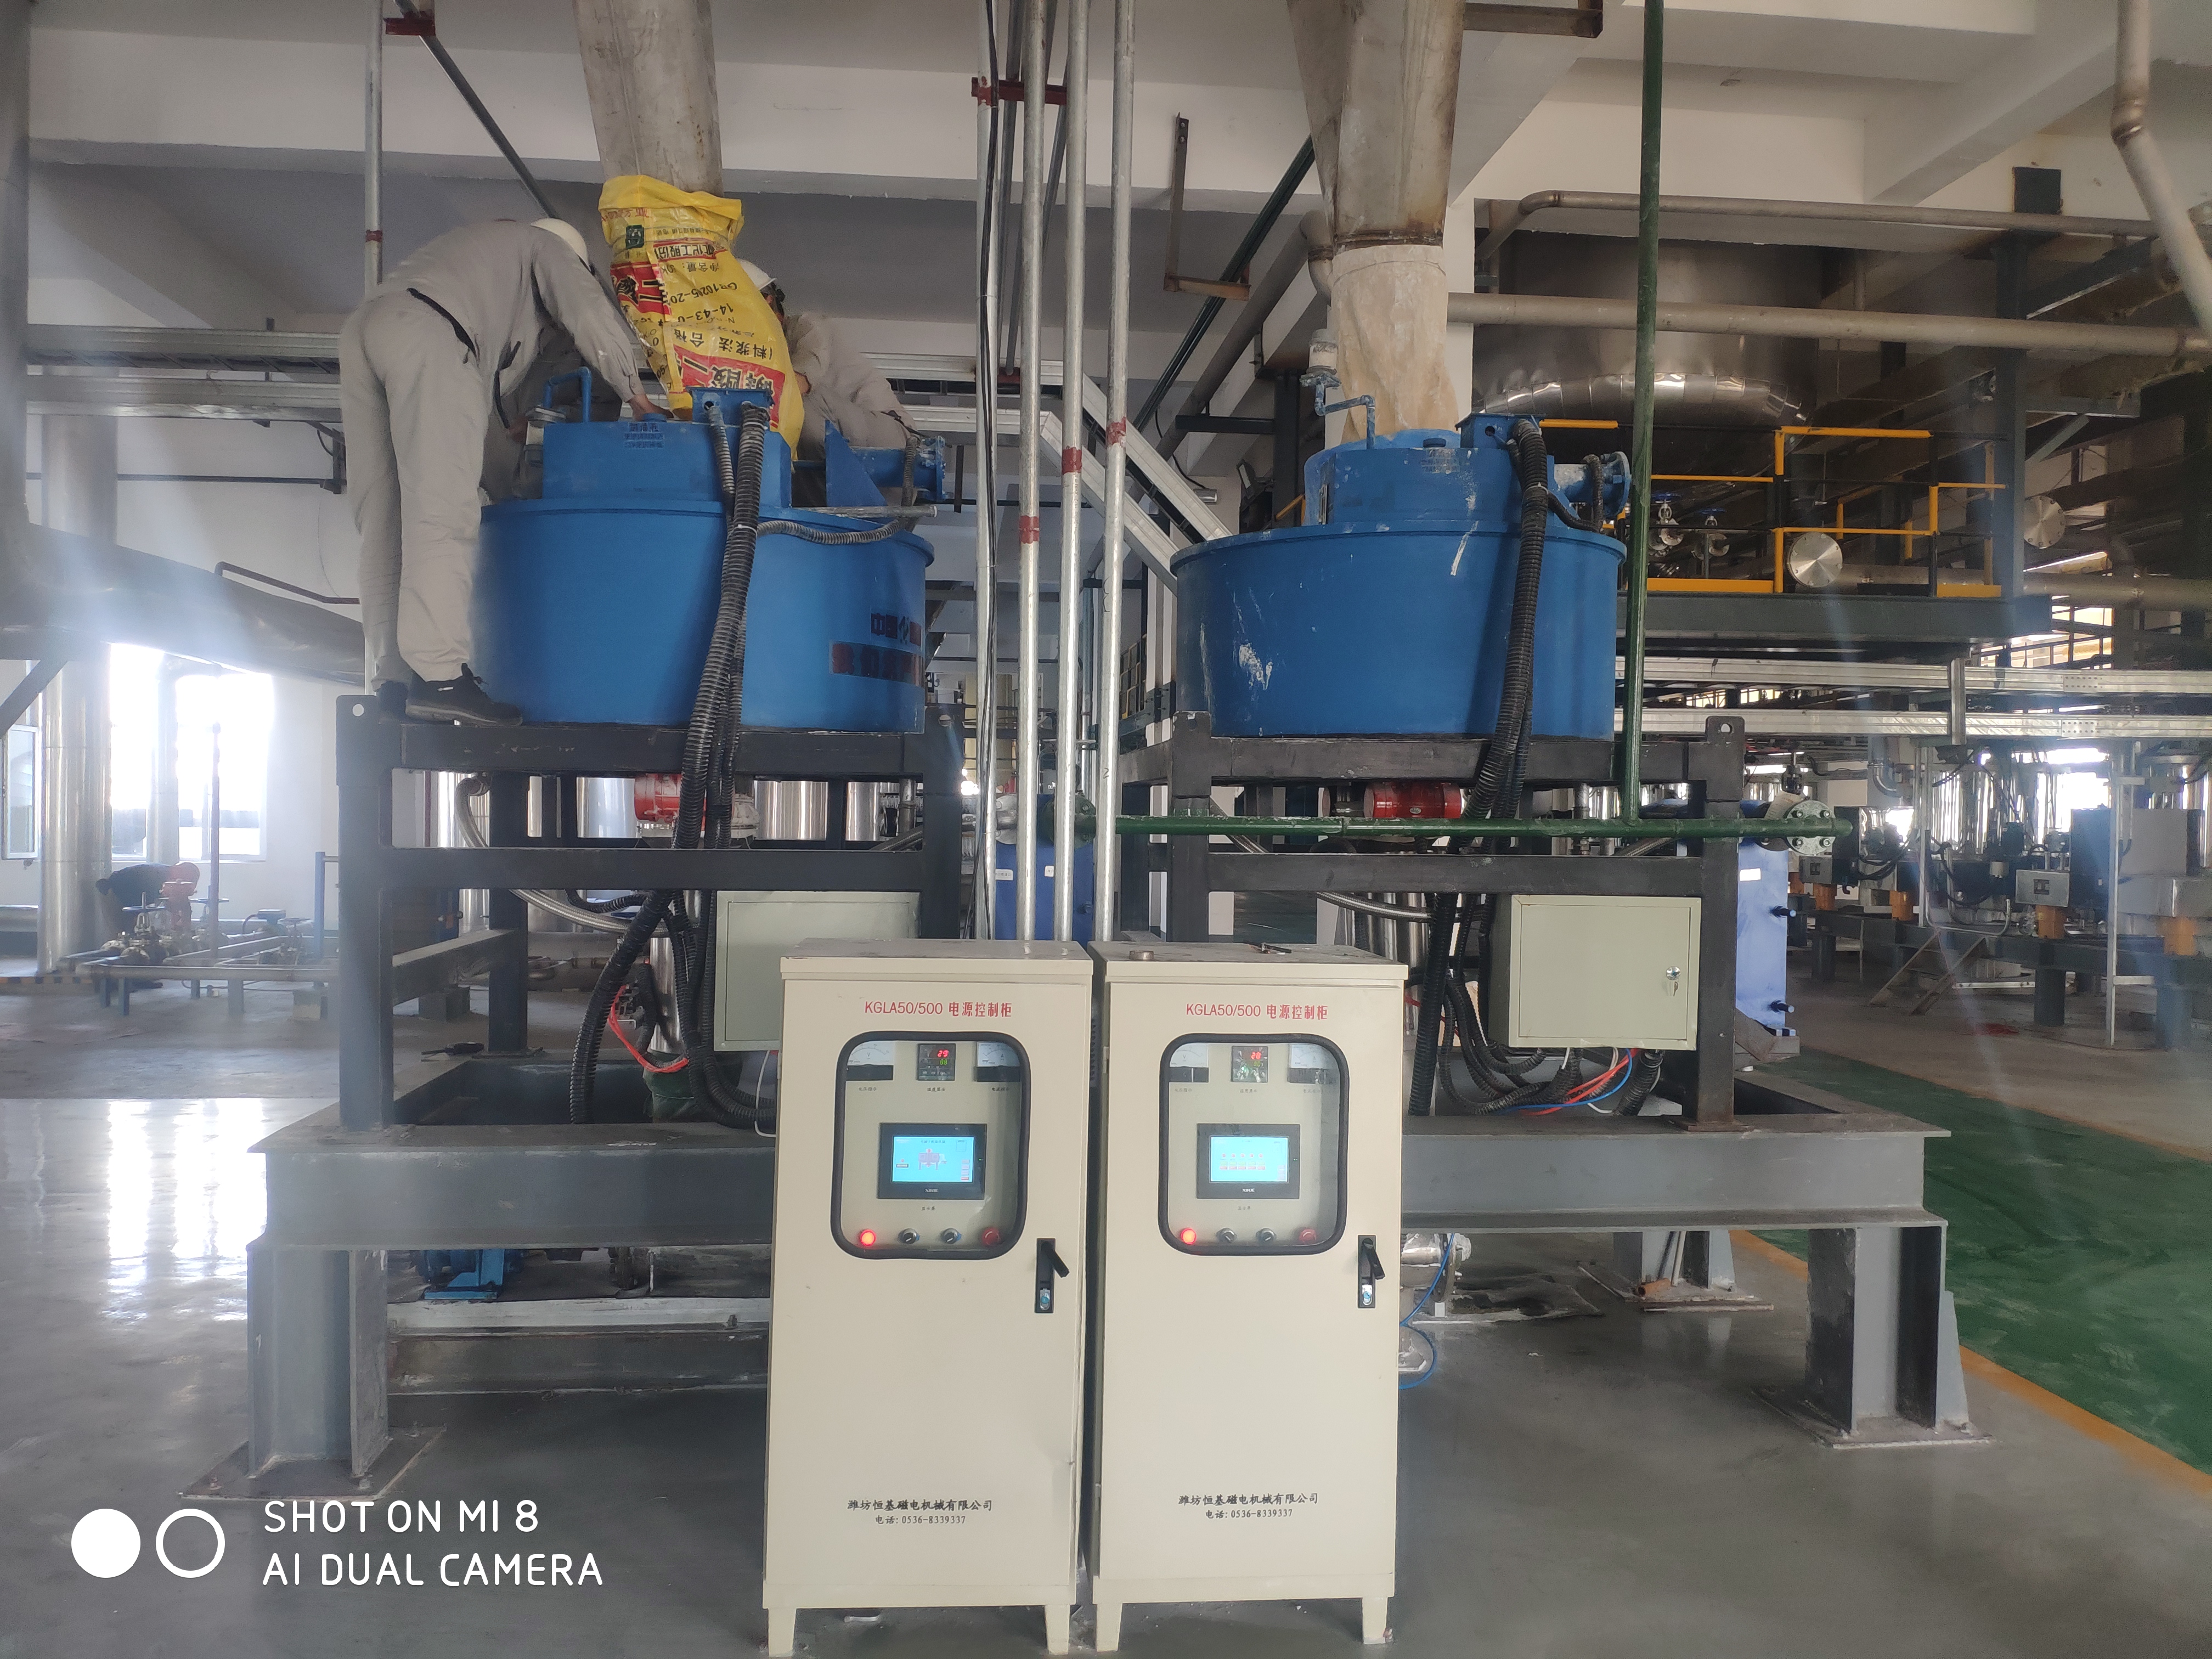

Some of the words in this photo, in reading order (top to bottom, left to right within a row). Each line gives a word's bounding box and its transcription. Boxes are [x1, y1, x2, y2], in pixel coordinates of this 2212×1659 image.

[865, 1001, 943, 1014] KGLA50/500
[949, 1001, 1012, 1018] 电源控制柜
[1186, 1003, 1261, 1017] KGLA50/500
[1266, 1004, 1328, 1020] 电源控制柜
[937, 1049, 949, 1058] 29
[847, 1499, 992, 1511] 潍坊恒基磁电机械有限公司
[1178, 1493, 1318, 1506] 潍坊恒基磁电机械有限公司
[875, 1515, 899, 1525] 电话:
[901, 1515, 966, 1524] 0536-8339337
[1205, 1509, 1228, 1519] 电话:
[1231, 1509, 1293, 1518] 0536-8339337
